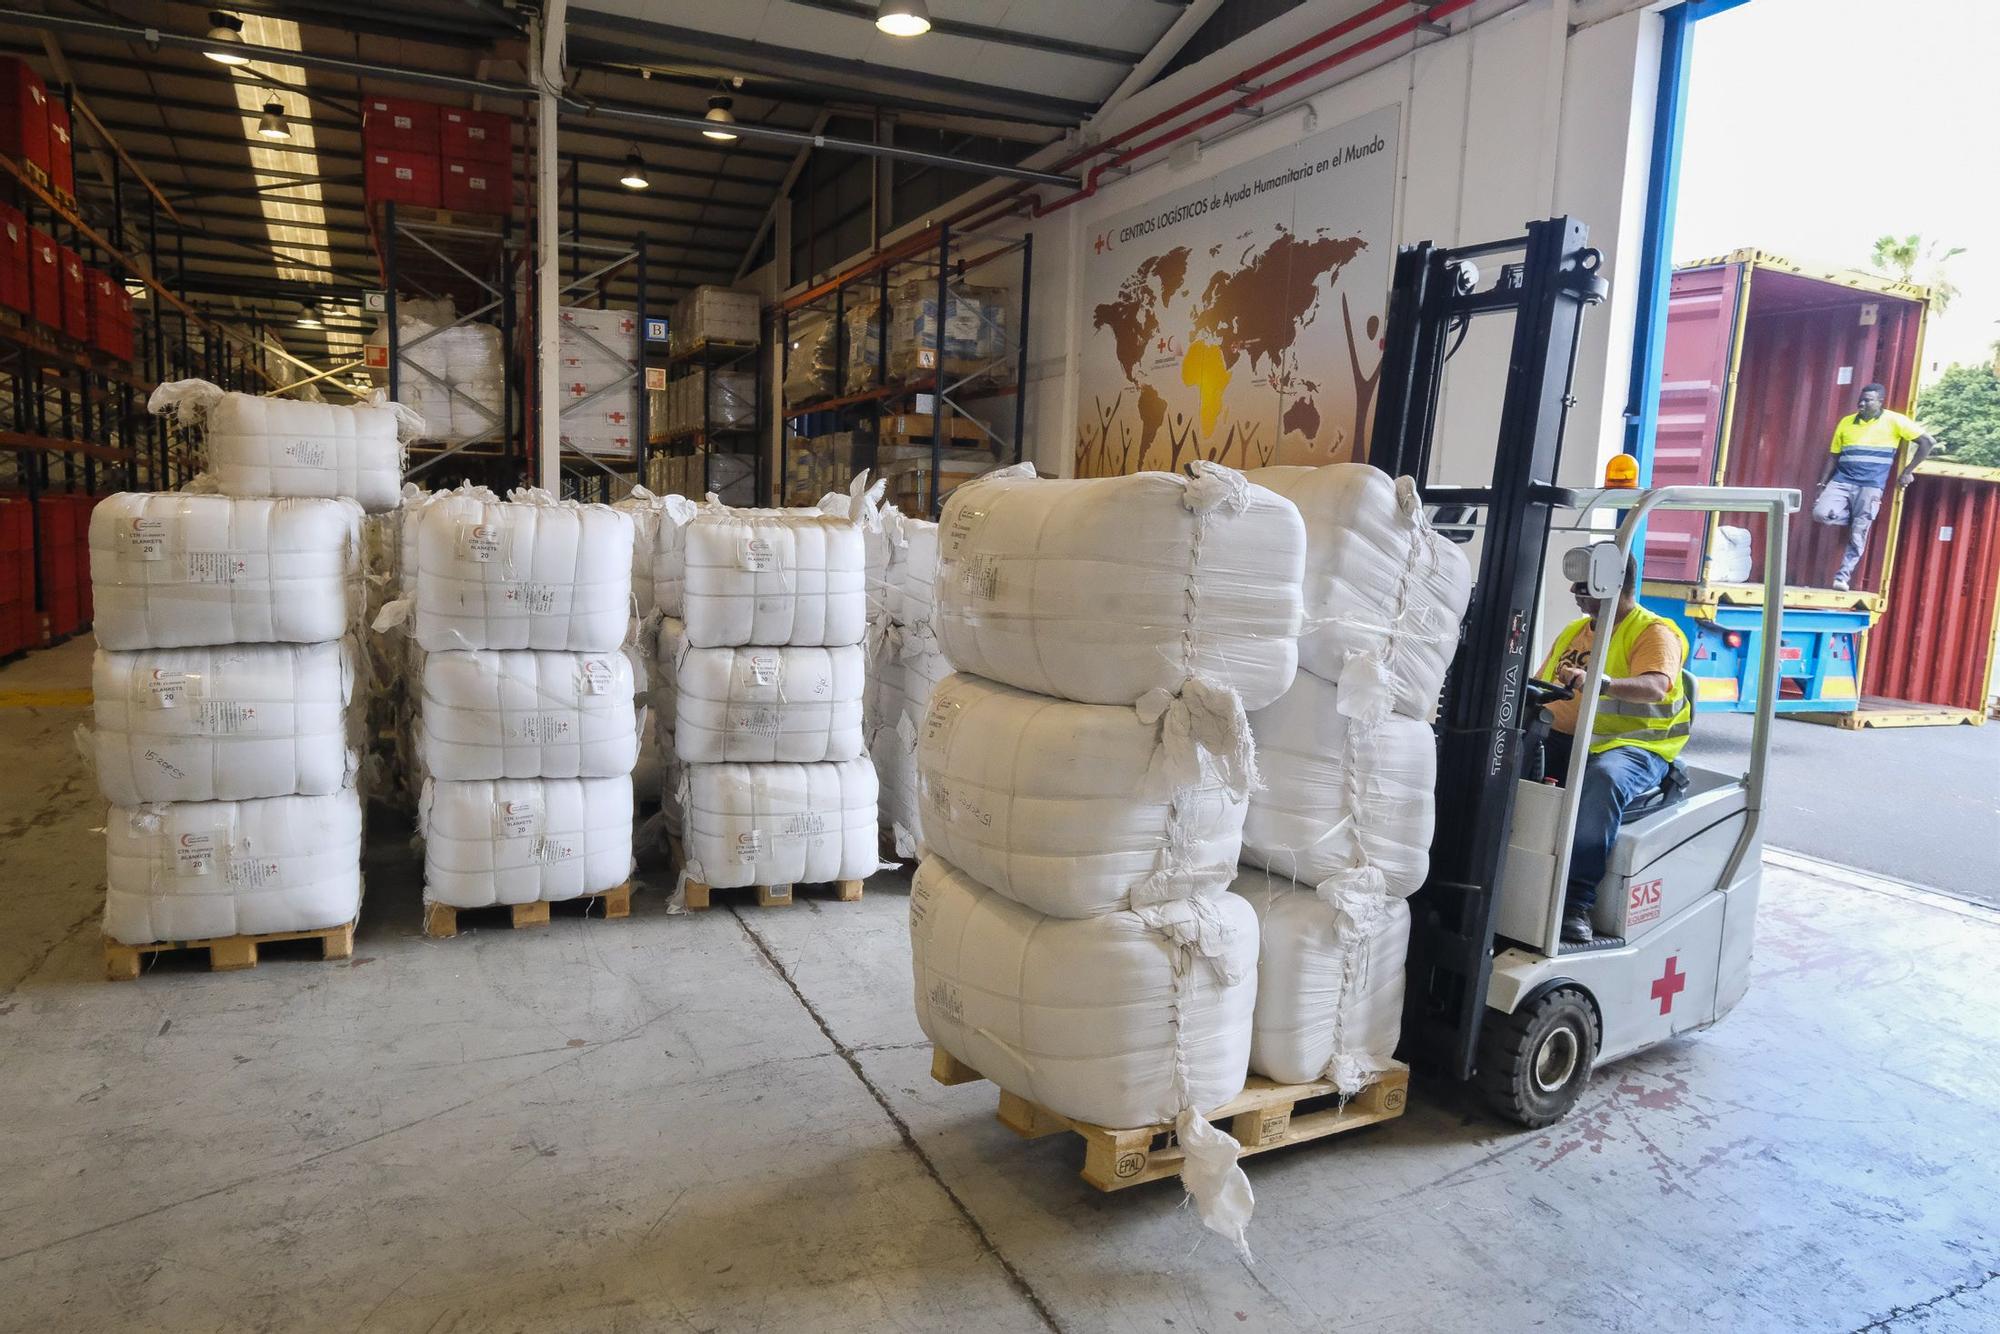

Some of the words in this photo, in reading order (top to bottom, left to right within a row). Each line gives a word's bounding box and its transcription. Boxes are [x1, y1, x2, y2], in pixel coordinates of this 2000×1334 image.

[1120, 217, 1155, 243] CENTROS
[1157, 199, 1208, 230] LOGÍSTICOS
[1210, 194, 1221, 211] de
[1223, 183, 1251, 208] Ayuda
[1254, 162, 1313, 196] Humanitaria
[1316, 160, 1329, 174] en
[1332, 148, 1342, 168] el
[1345, 135, 1385, 164] Mundo
[652, 324, 662, 335] B
[924, 353, 931, 363] A
[1491, 664, 1519, 776] TOYOTA
[1630, 880, 1661, 909] SAS
[1118, 1156, 1140, 1174] EPAL
